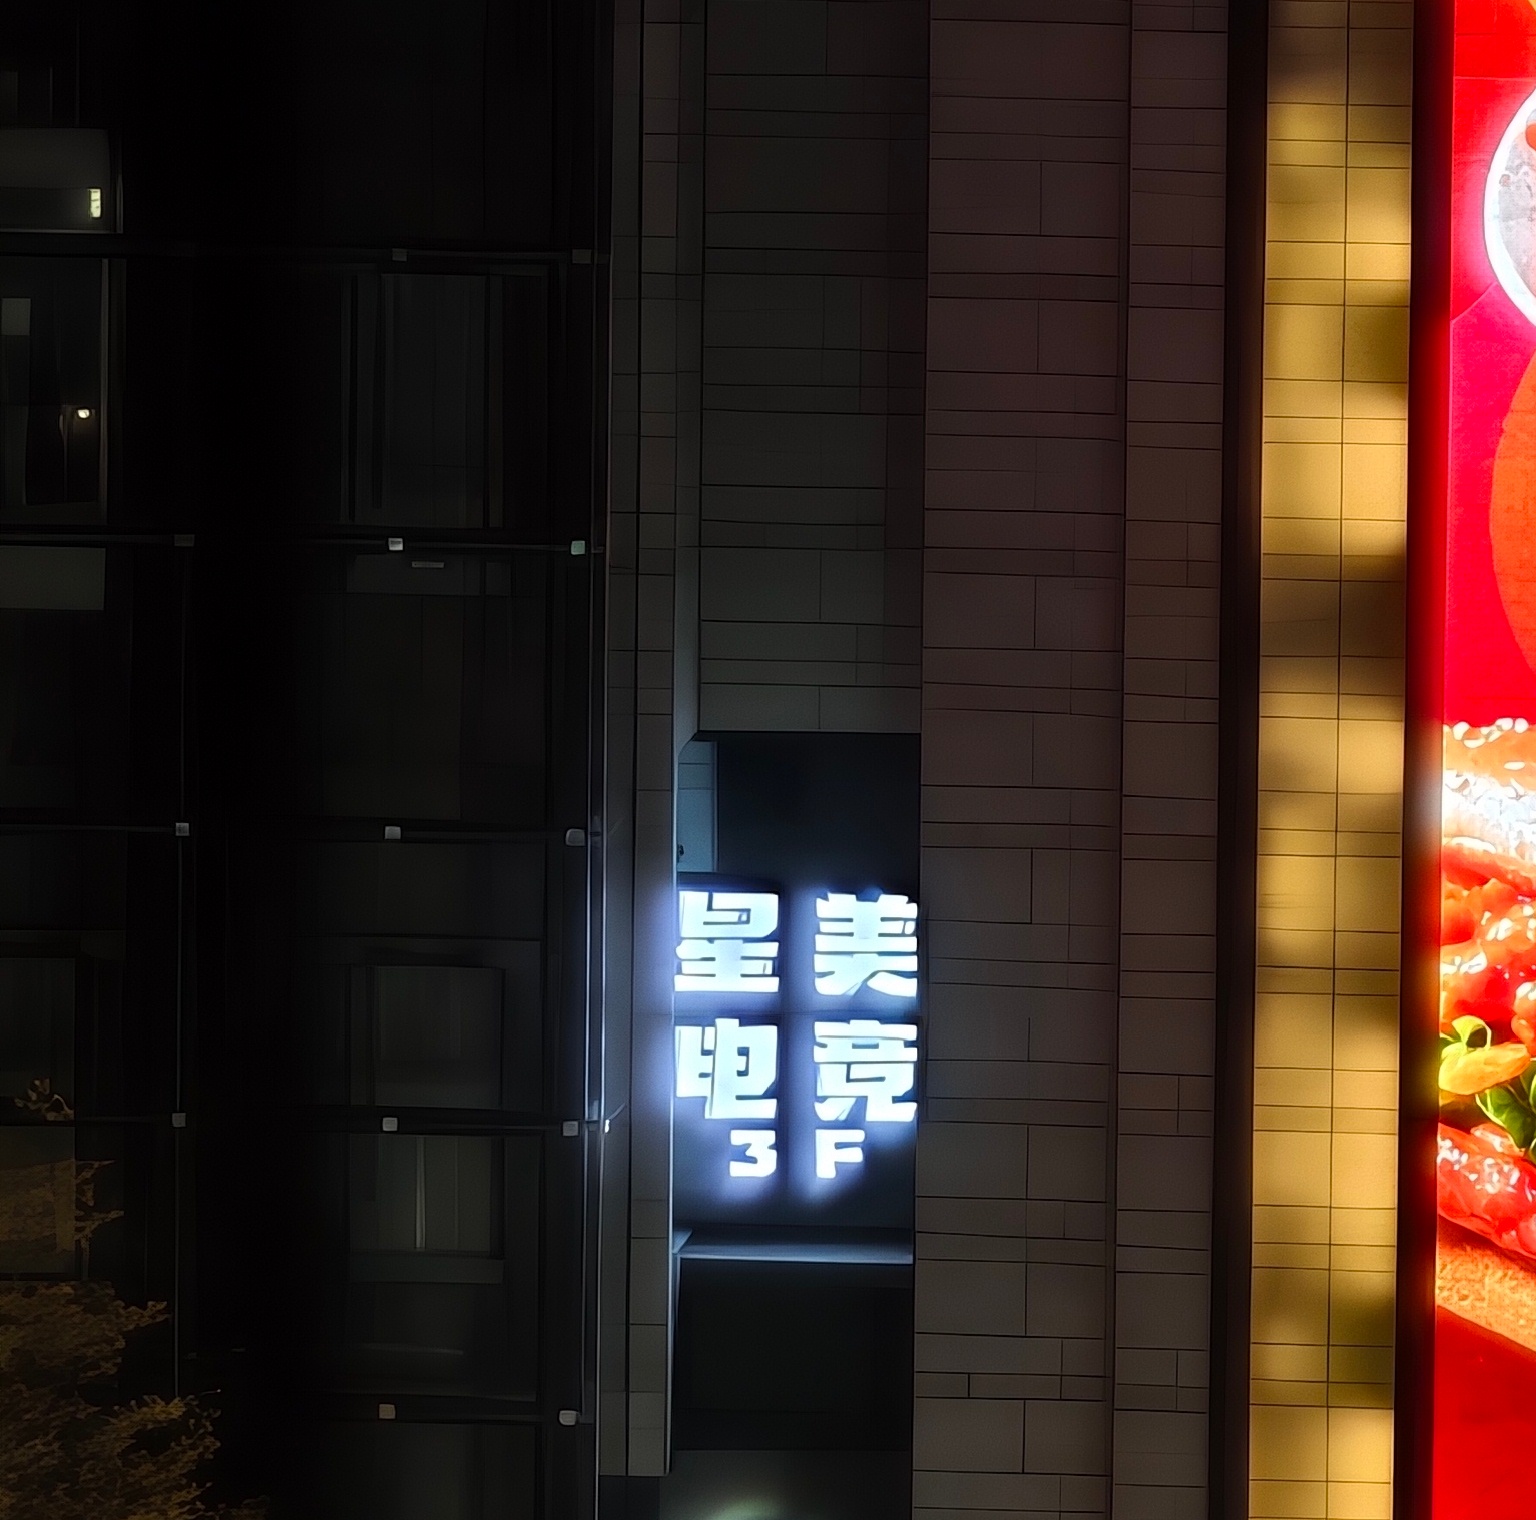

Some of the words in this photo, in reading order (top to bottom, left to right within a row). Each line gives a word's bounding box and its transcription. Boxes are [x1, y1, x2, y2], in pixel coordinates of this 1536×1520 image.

[675, 892, 918, 997] 星美
[675, 1019, 918, 1122] 电竞
[729, 1129, 865, 1179] 3F
